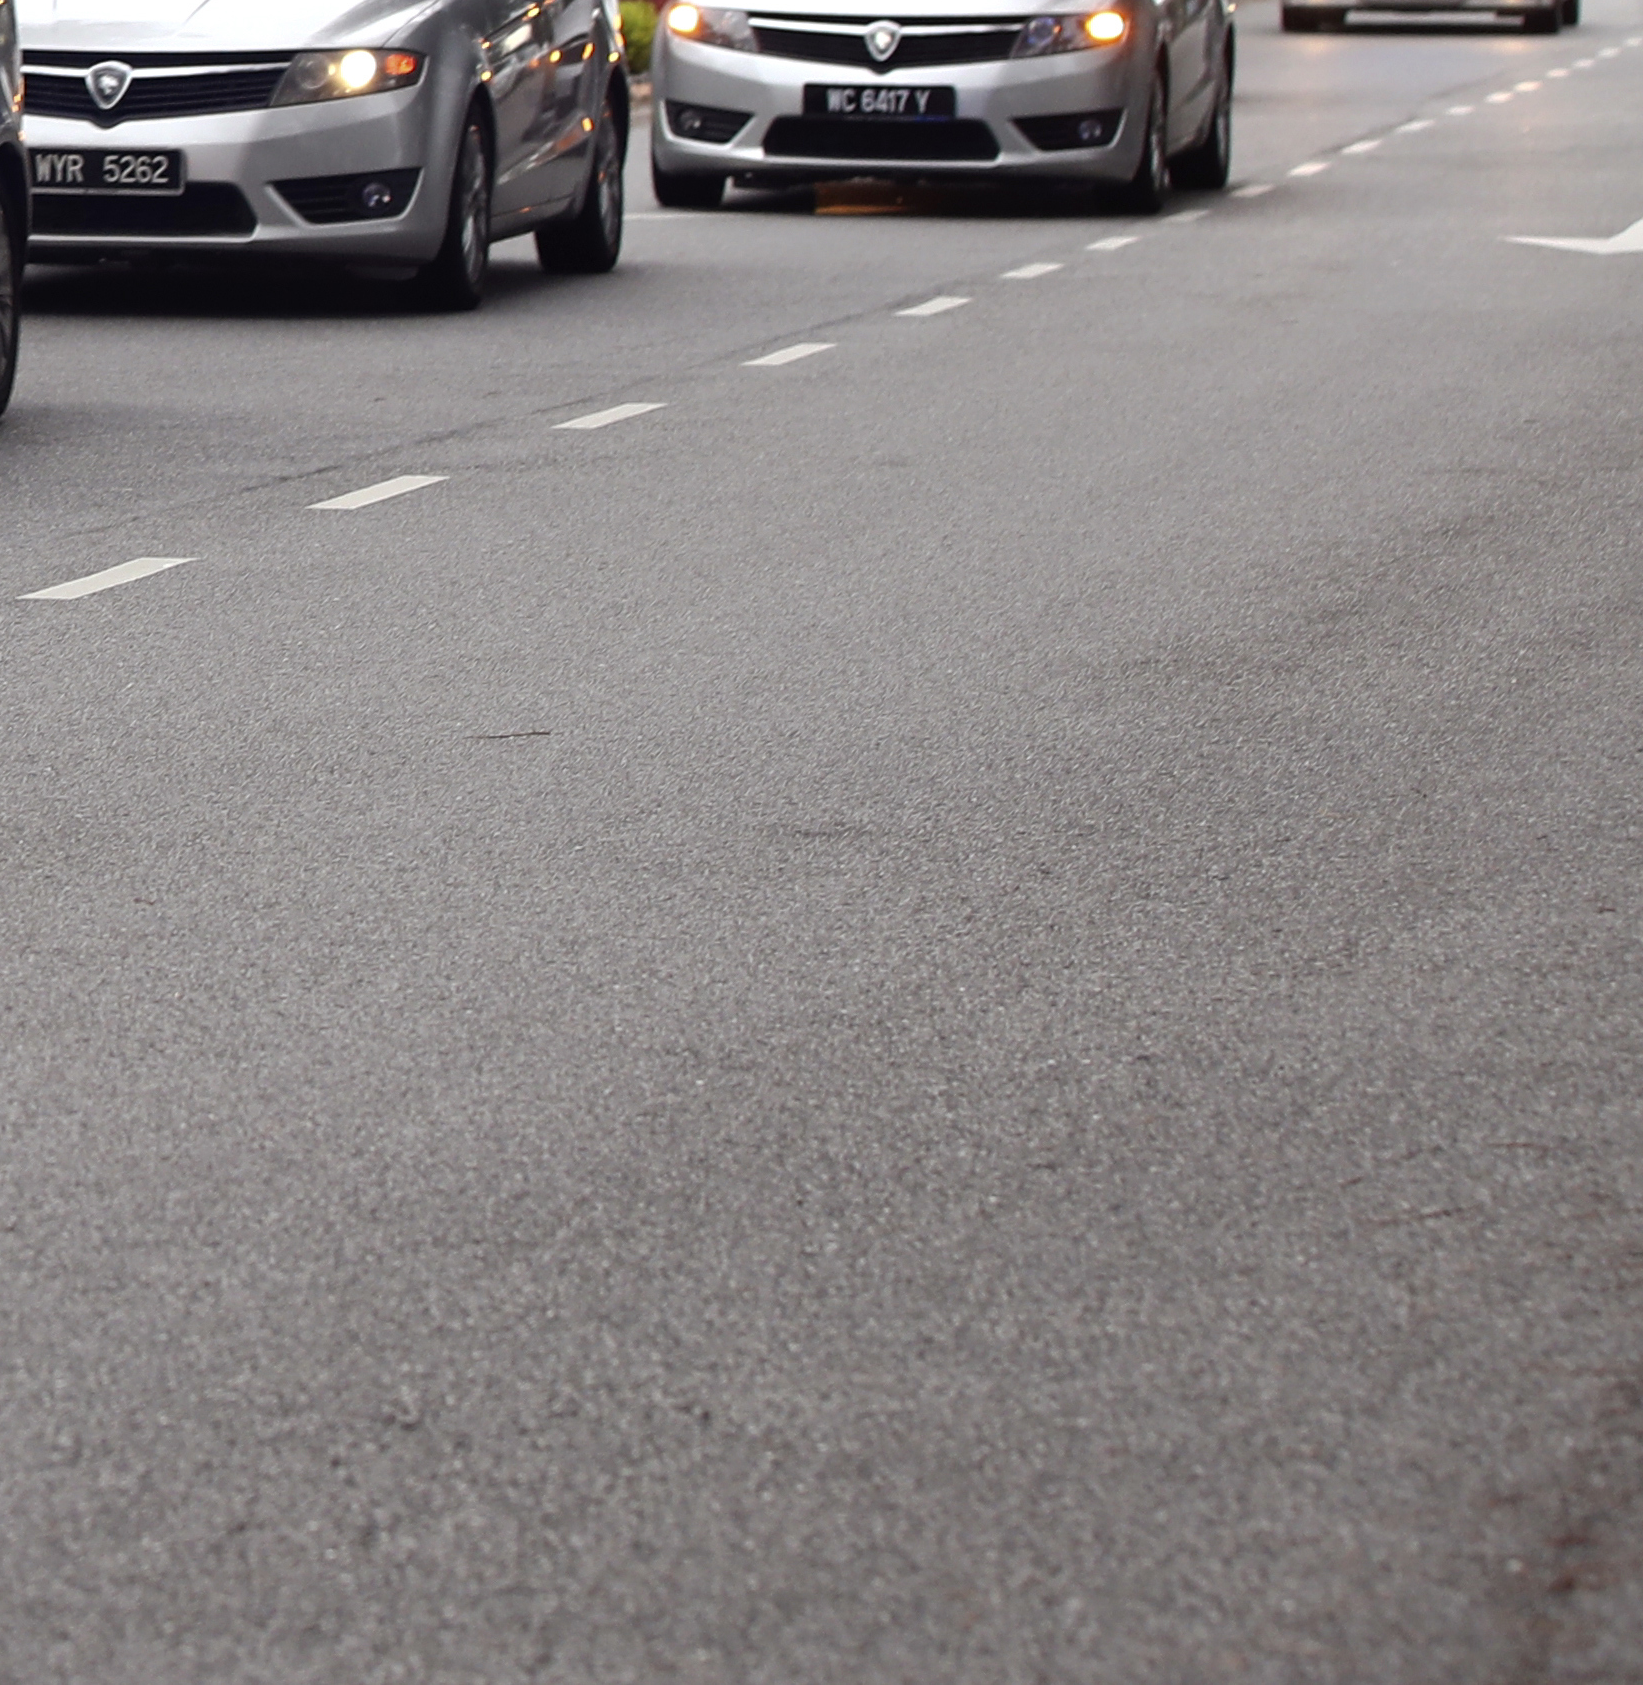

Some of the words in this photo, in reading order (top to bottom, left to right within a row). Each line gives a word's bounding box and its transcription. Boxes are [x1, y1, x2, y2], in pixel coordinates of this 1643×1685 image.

[861, 88, 910, 113] 6417
[916, 89, 931, 113] Y
[35, 154, 84, 183] WYR
[103, 155, 169, 183] 5262
